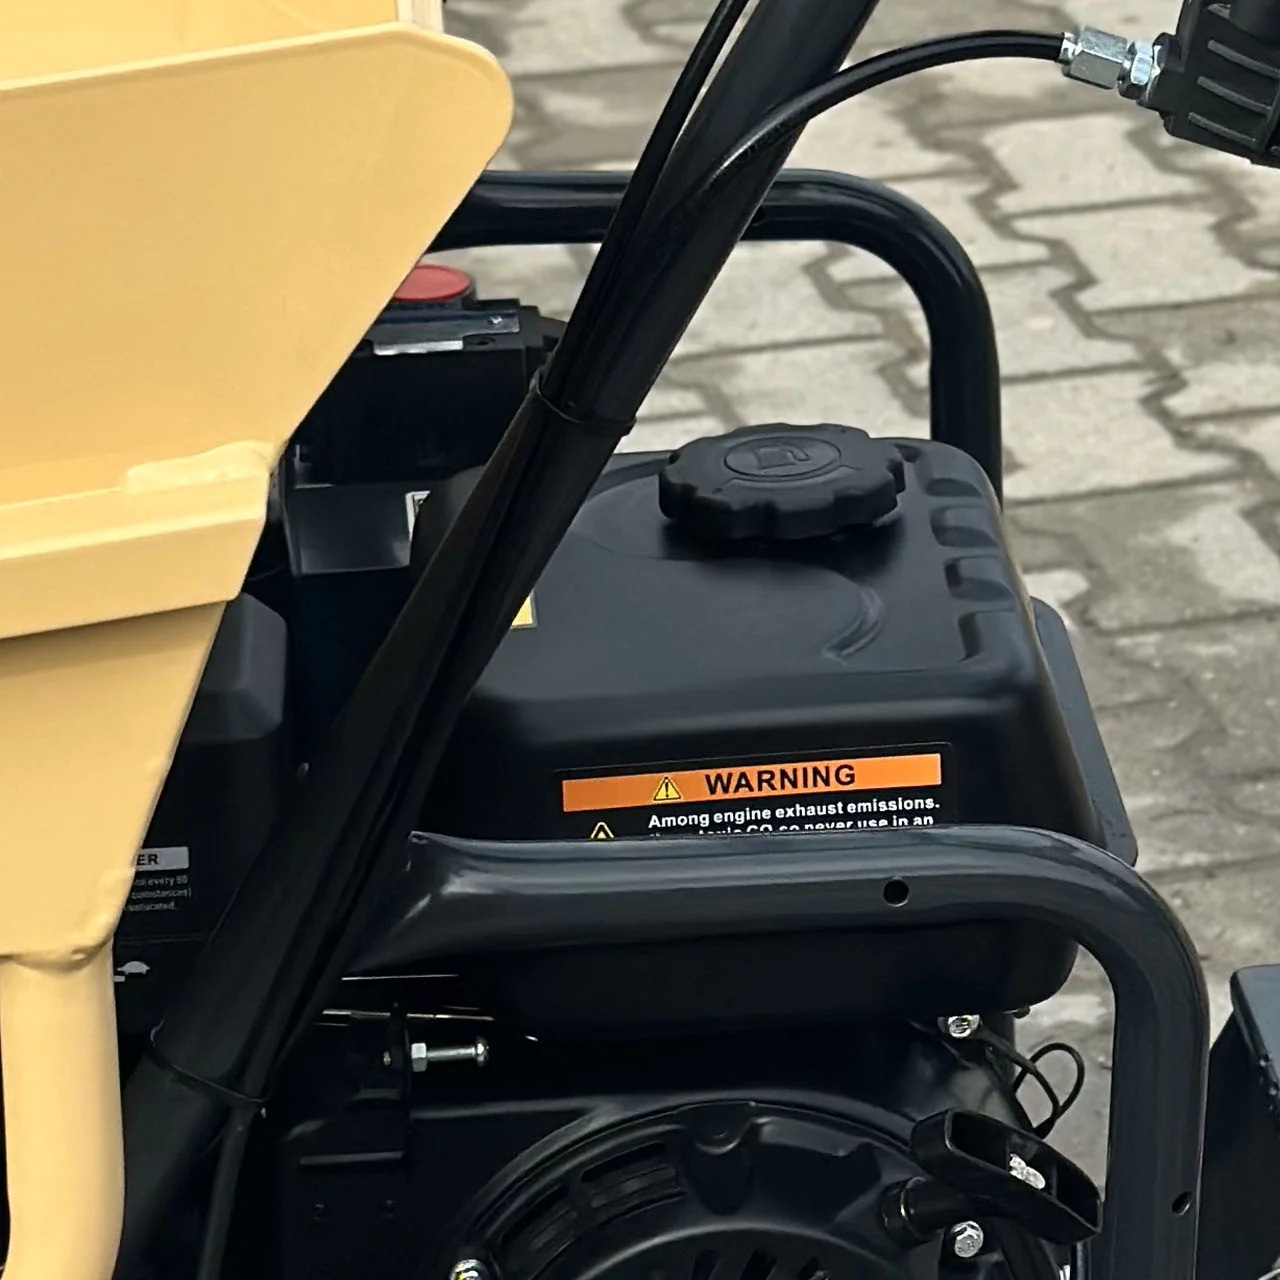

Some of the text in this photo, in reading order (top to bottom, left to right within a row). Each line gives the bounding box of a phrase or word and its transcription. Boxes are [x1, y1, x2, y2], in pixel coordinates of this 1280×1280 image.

[705, 764, 857, 796] WARNING
[648, 797, 940, 828] Among engine exhaust emissions.
[892, 815, 908, 827] in
[913, 815, 934, 826] an
[137, 854, 159, 866] ER
